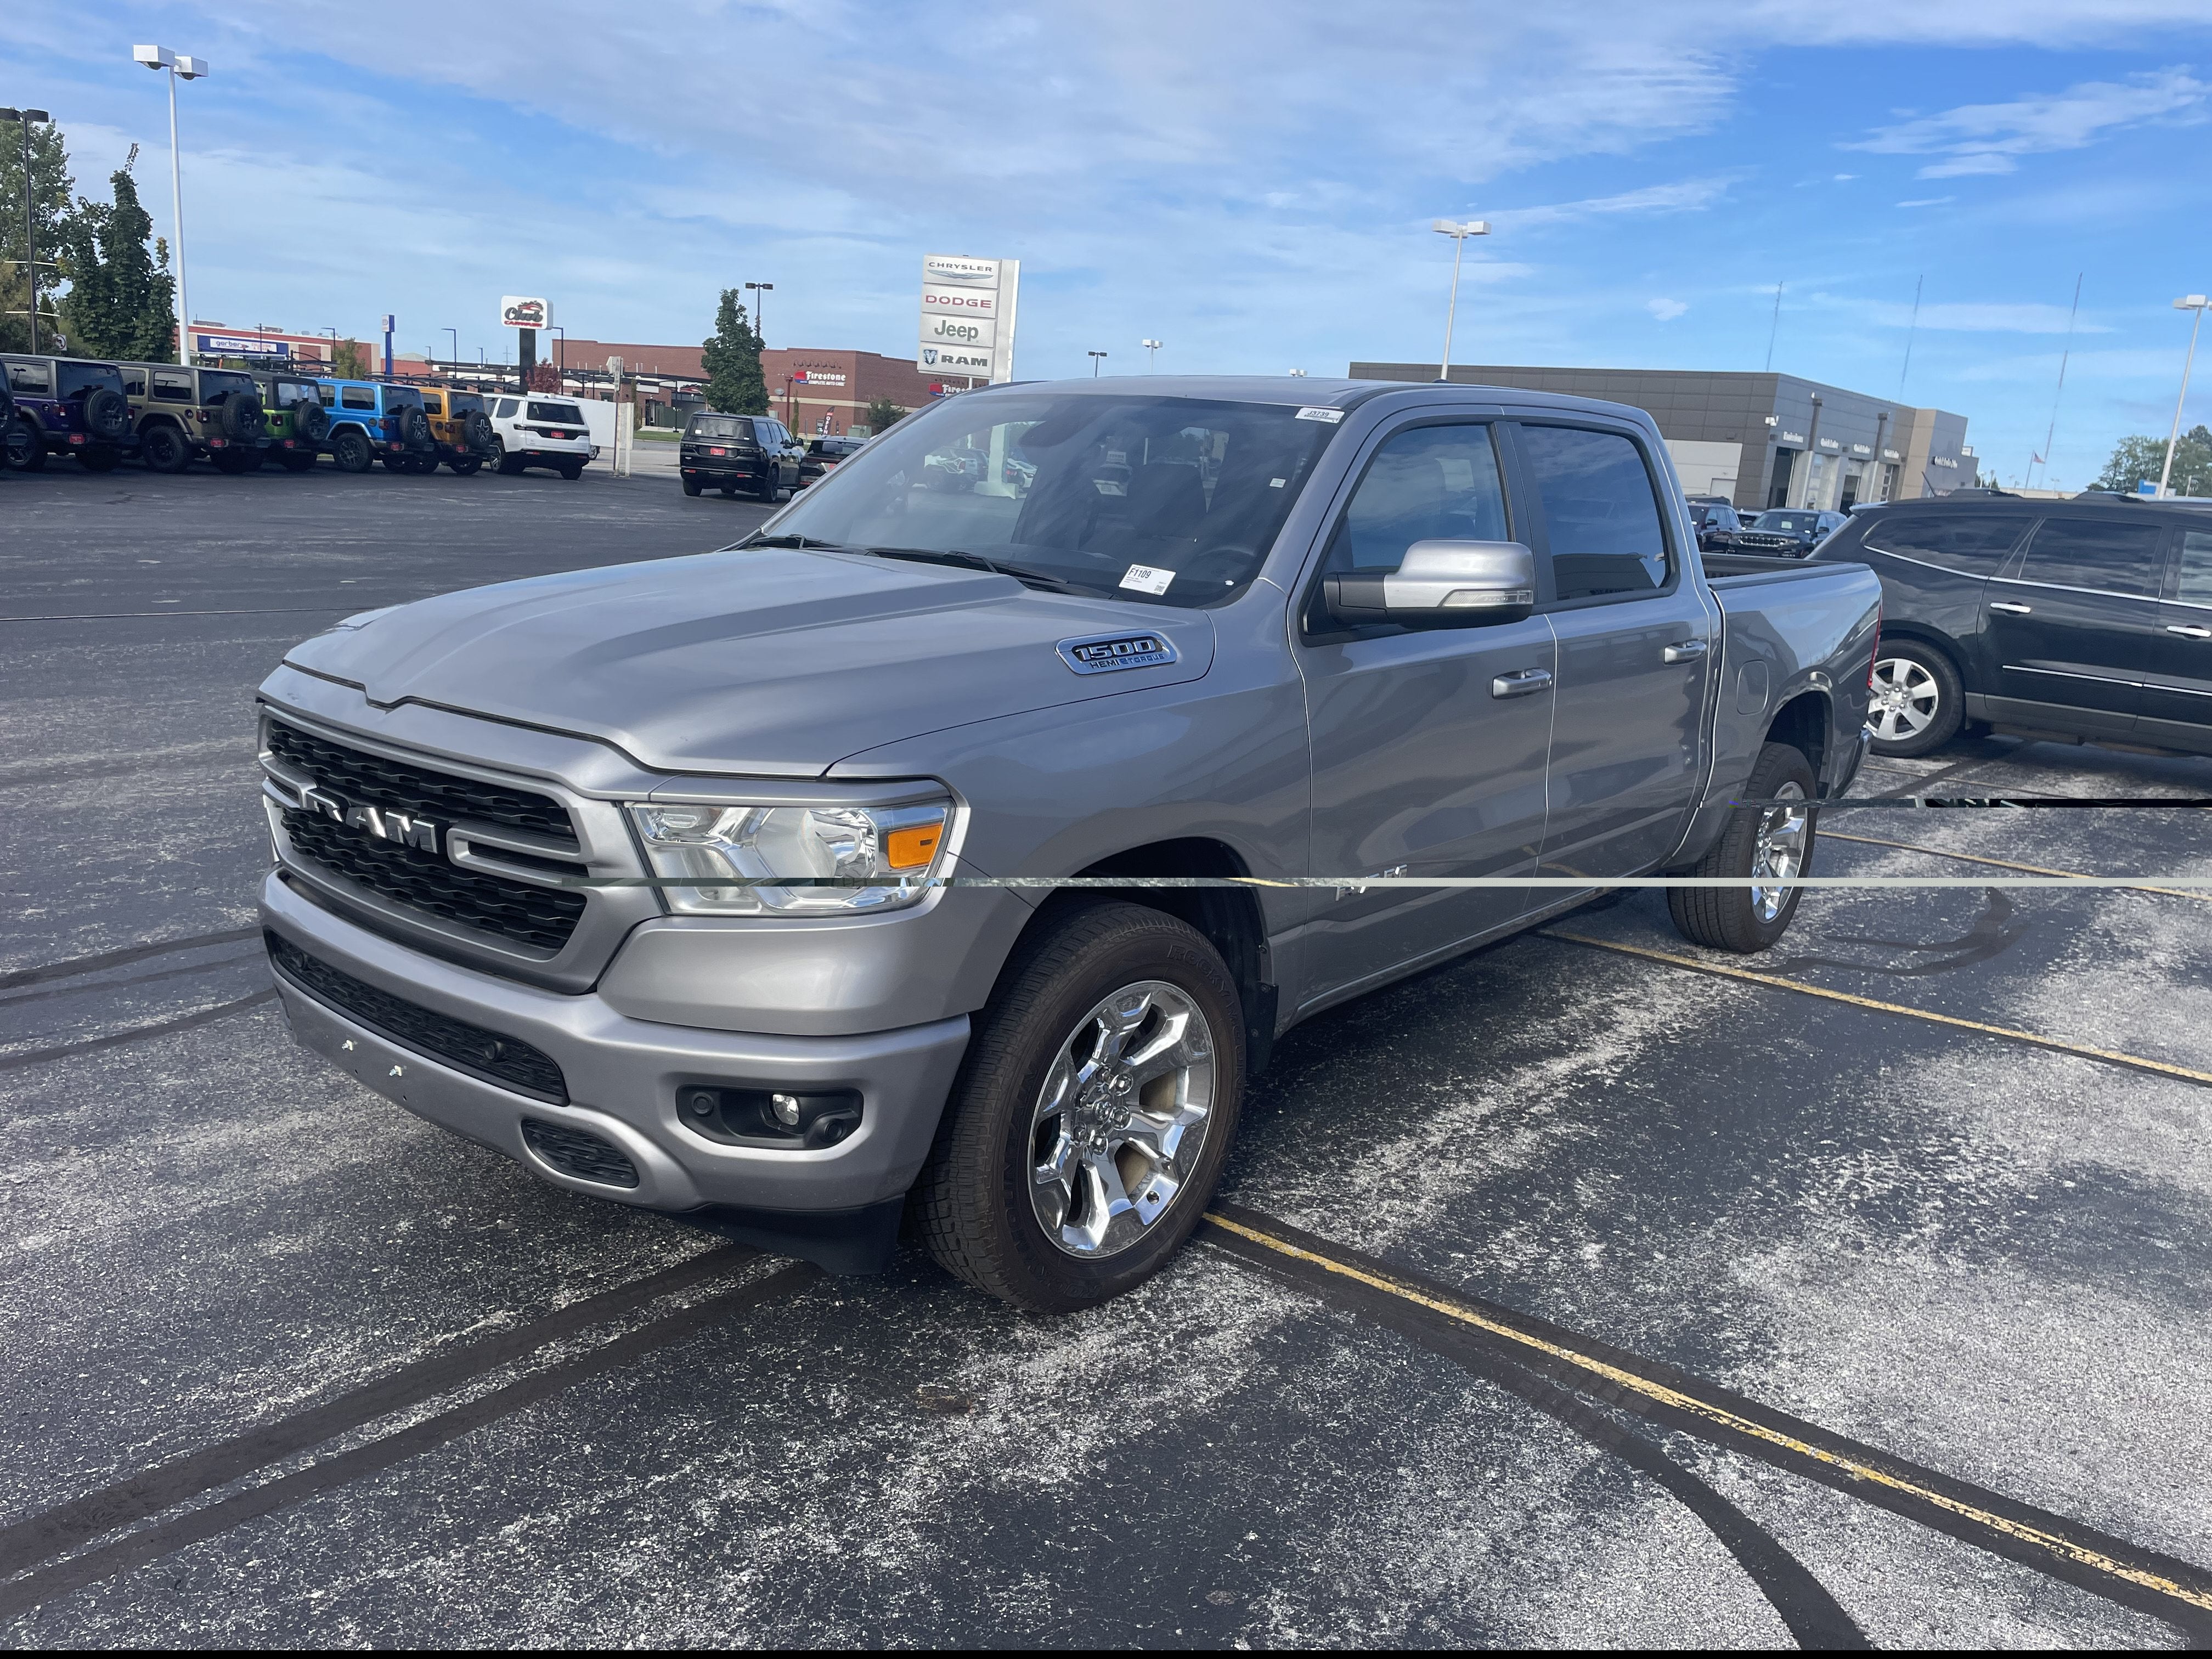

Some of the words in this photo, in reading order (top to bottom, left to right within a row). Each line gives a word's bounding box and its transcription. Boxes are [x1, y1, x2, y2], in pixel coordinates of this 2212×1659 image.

[928, 262, 992, 272] CHRYSLER
[925, 295, 992, 308] DODGE
[934, 319, 979, 342] Jeep
[941, 354, 988, 367] RAM
[805, 371, 846, 381] Firestone
[1128, 568, 1152, 579] F1109
[1074, 639, 1156, 661] 1500
[1089, 659, 1120, 669] HEMI
[306, 791, 438, 854] RAM
